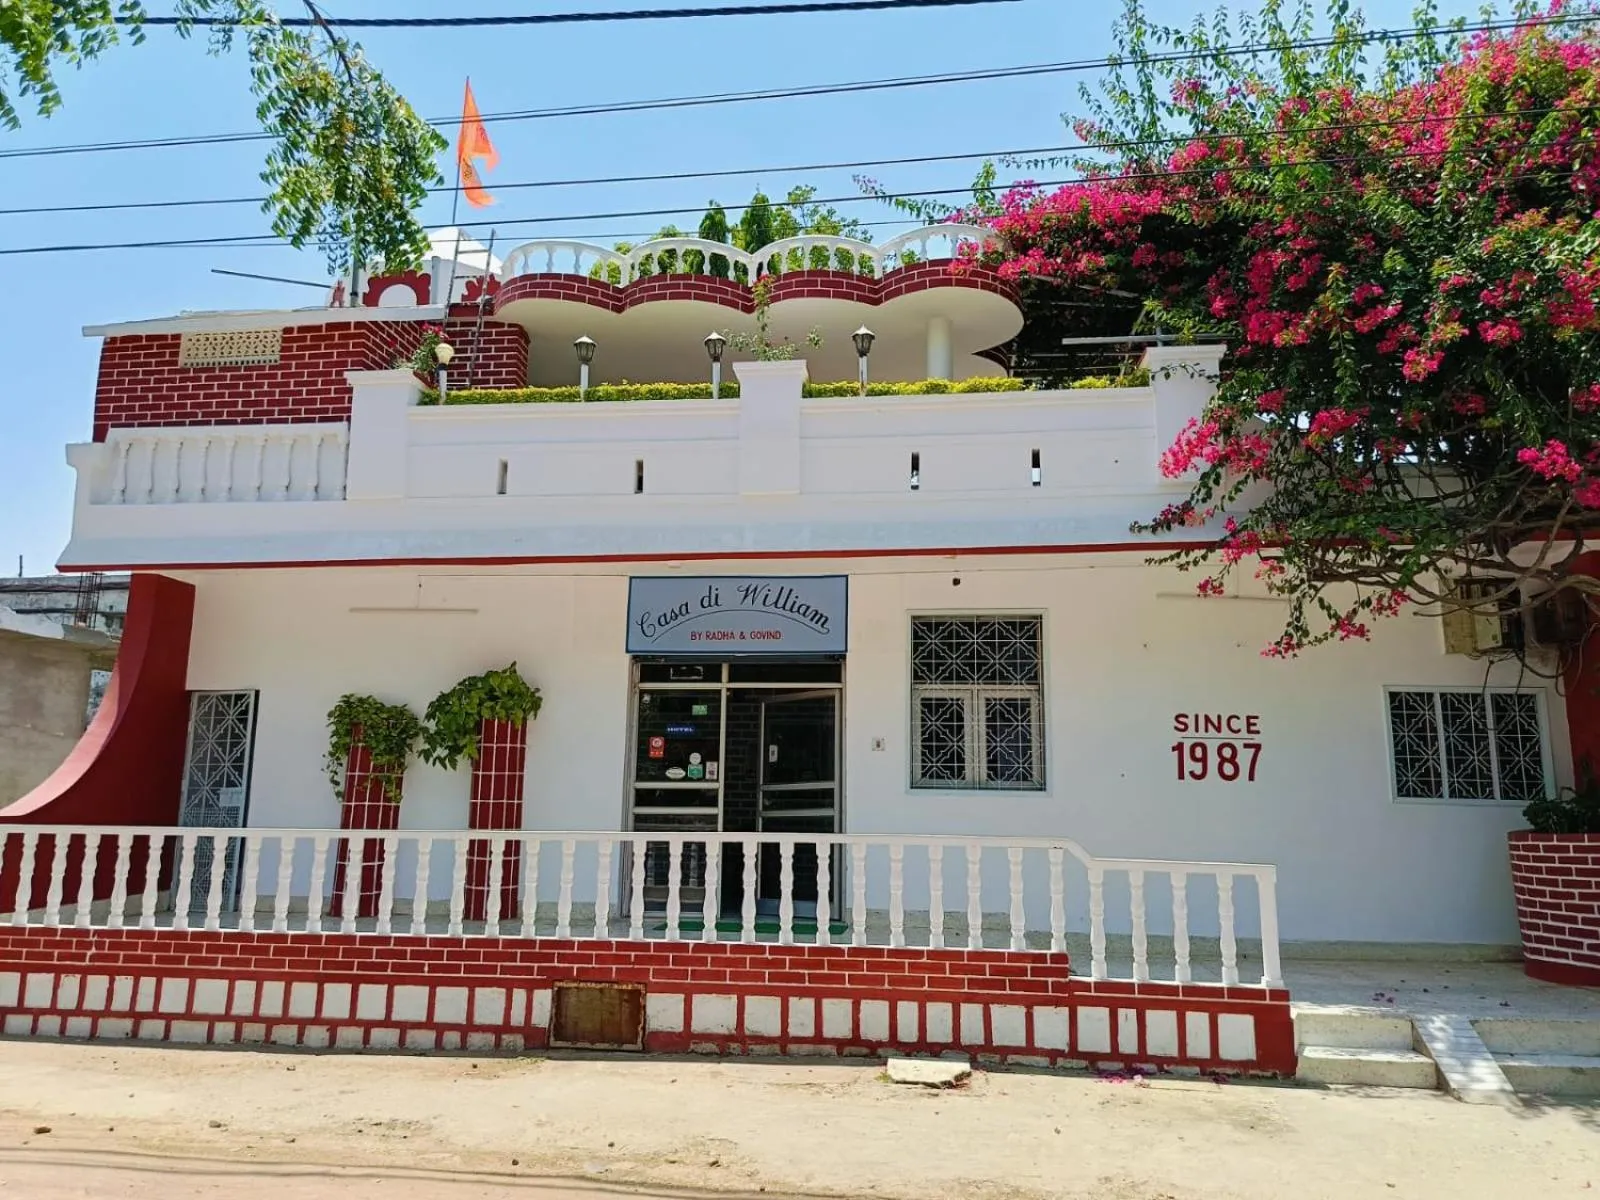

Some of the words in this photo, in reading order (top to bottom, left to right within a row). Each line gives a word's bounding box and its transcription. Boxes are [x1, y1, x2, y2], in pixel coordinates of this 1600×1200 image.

[636, 600, 692, 638] Casa
[699, 585, 722, 608] di
[736, 582, 830, 635] William
[690, 630, 703, 641] BY
[705, 630, 735, 640] RADHA
[739, 630, 746, 640] &
[750, 630, 782, 641] GOVIND
[1173, 712, 1261, 735] SINCE
[1171, 741, 1262, 782] 1987
